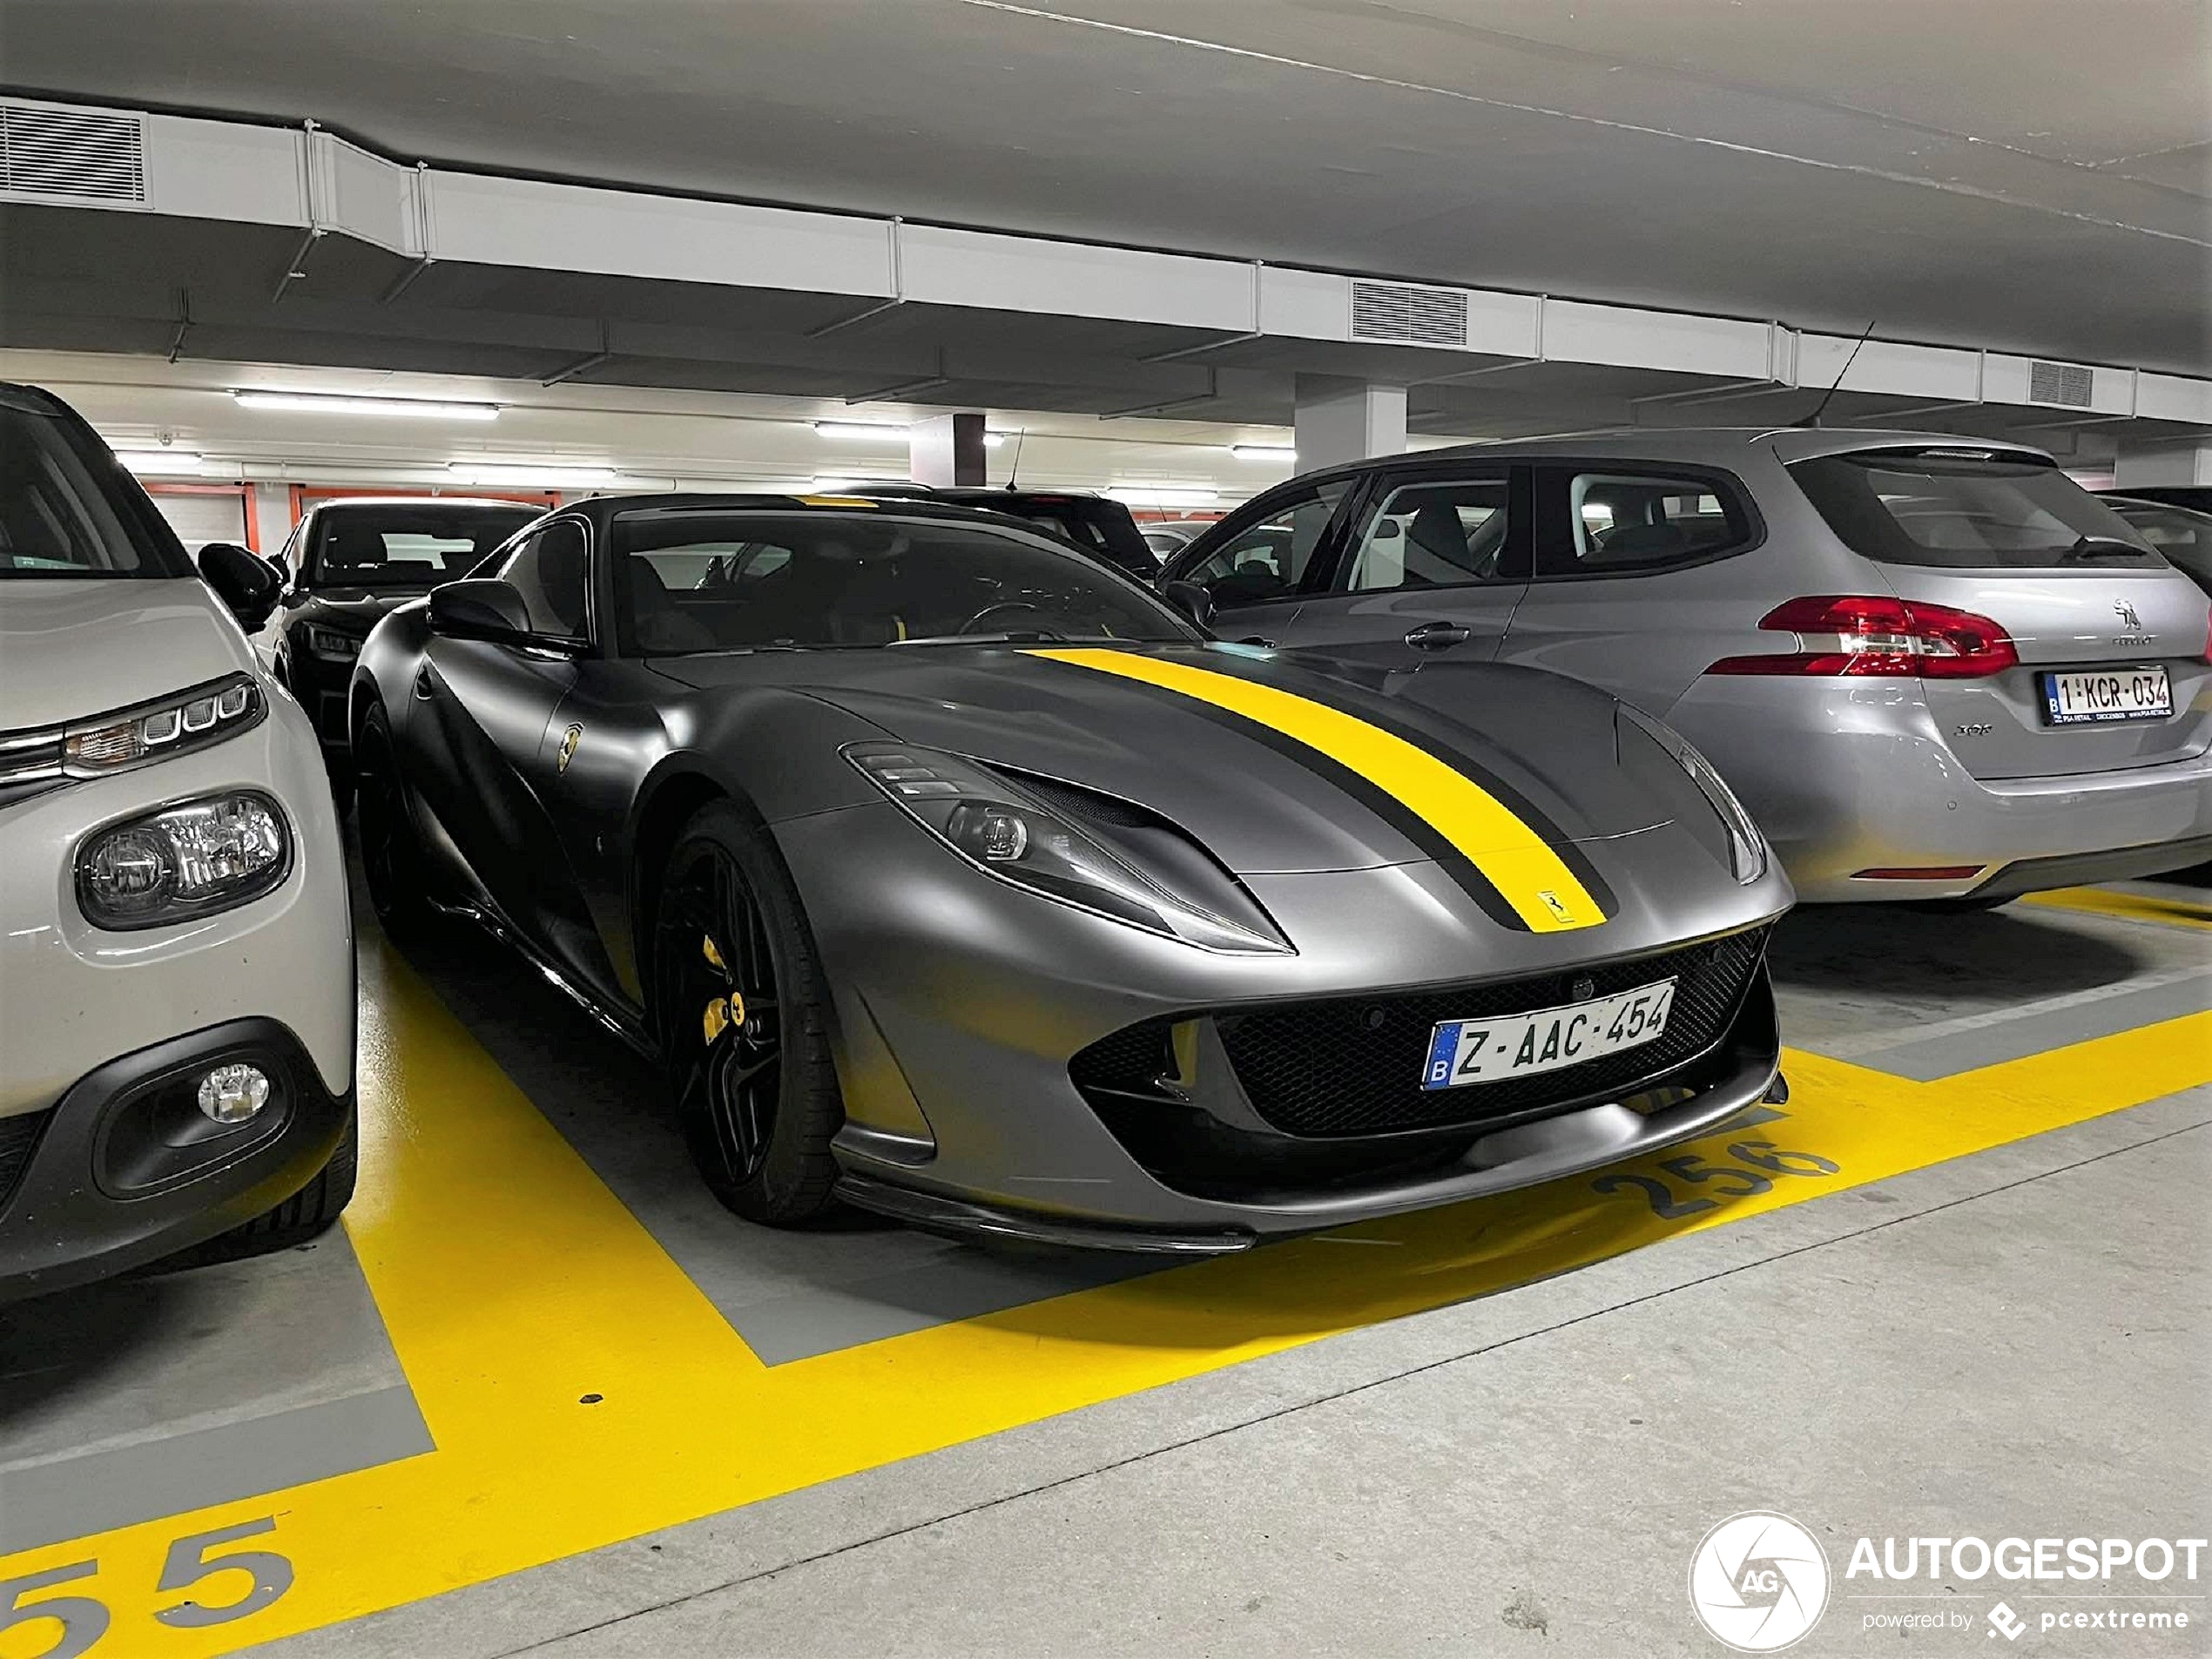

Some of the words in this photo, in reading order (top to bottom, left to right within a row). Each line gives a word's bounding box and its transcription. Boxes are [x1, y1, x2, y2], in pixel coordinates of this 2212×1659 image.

[2049, 698, 2060, 712] B
[1457, 989, 1670, 1076] Z-AAC-454
[1431, 1061, 1448, 1082] B
[1589, 1141, 1840, 1219] 256
